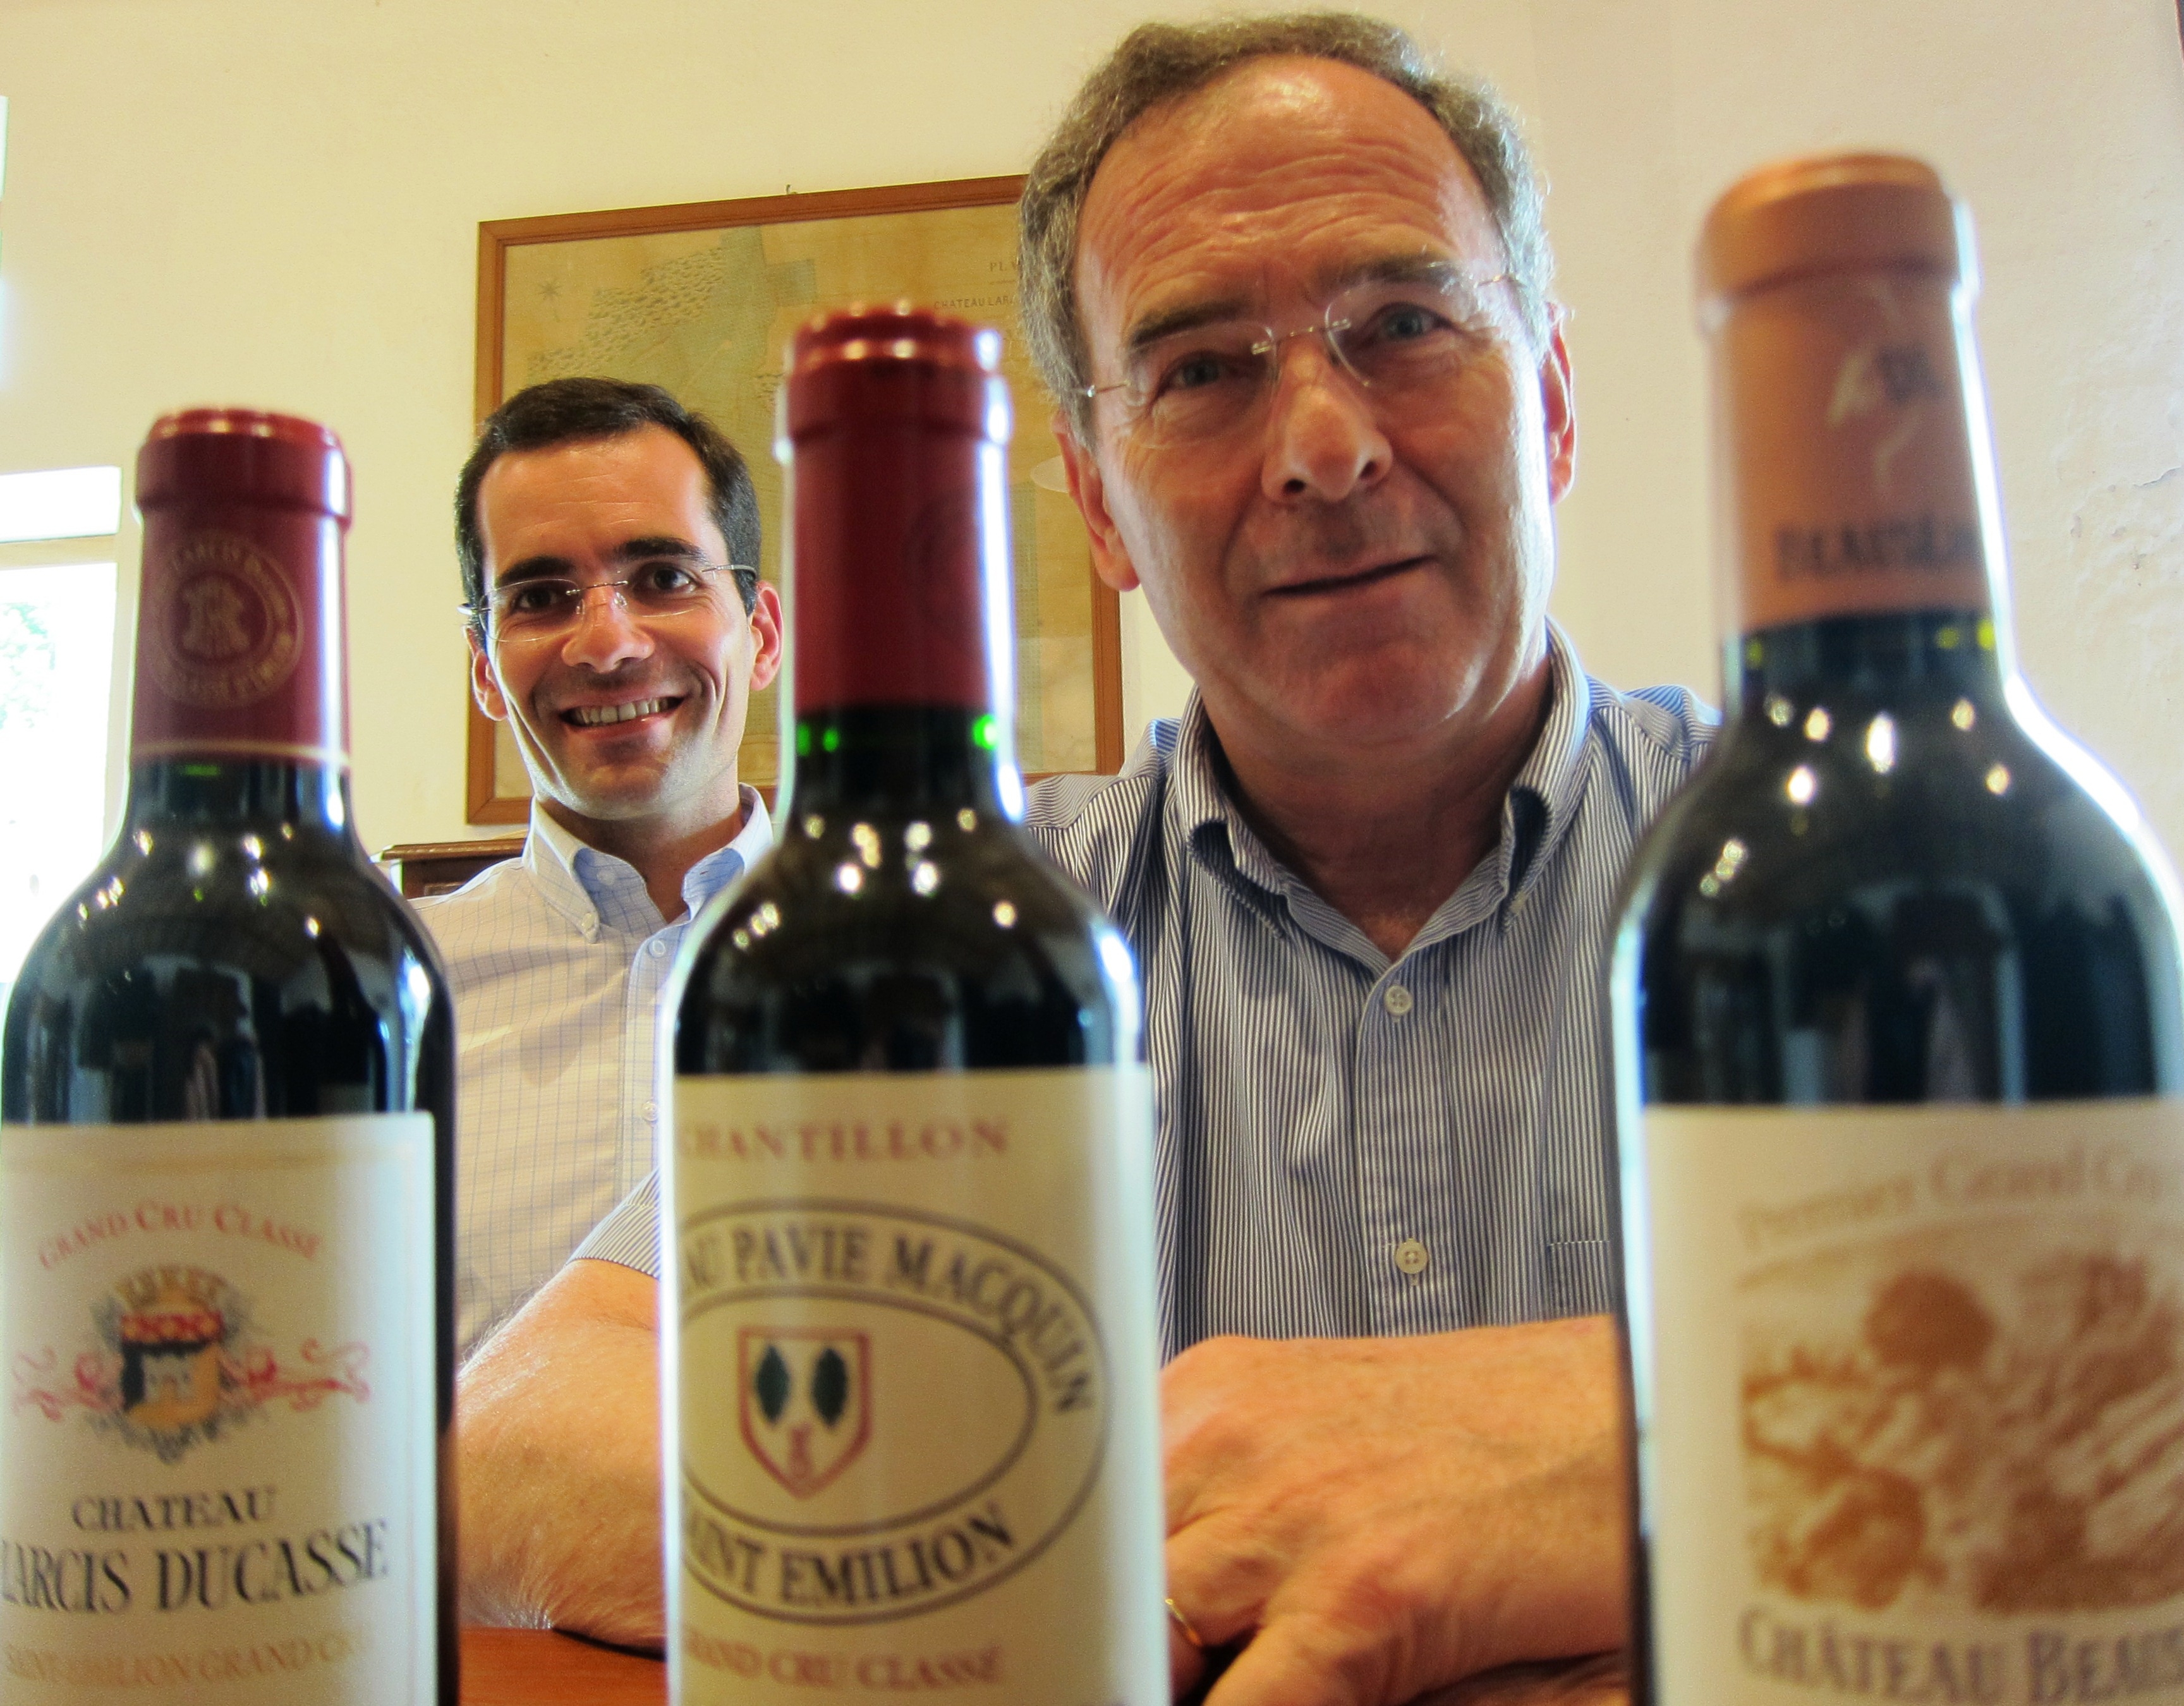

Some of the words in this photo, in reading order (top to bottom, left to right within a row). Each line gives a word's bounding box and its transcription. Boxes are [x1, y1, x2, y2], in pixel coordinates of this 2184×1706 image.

[934, 298, 985, 310] CHATEAU
[988, 295, 1012, 306] LAR
[37, 1210, 128, 1271] GRAND
[133, 1199, 205, 1232] CRU
[731, 1223, 870, 1285] PAVIE
[886, 1233, 1095, 1415] MACQUIN
[71, 1484, 277, 1532] CHATEAU
[155, 1519, 389, 1611] DUCASSE
[781, 1499, 1014, 1606] EMILION
[198, 1636, 314, 1683] GRAND
[768, 1649, 849, 1690] CRU
